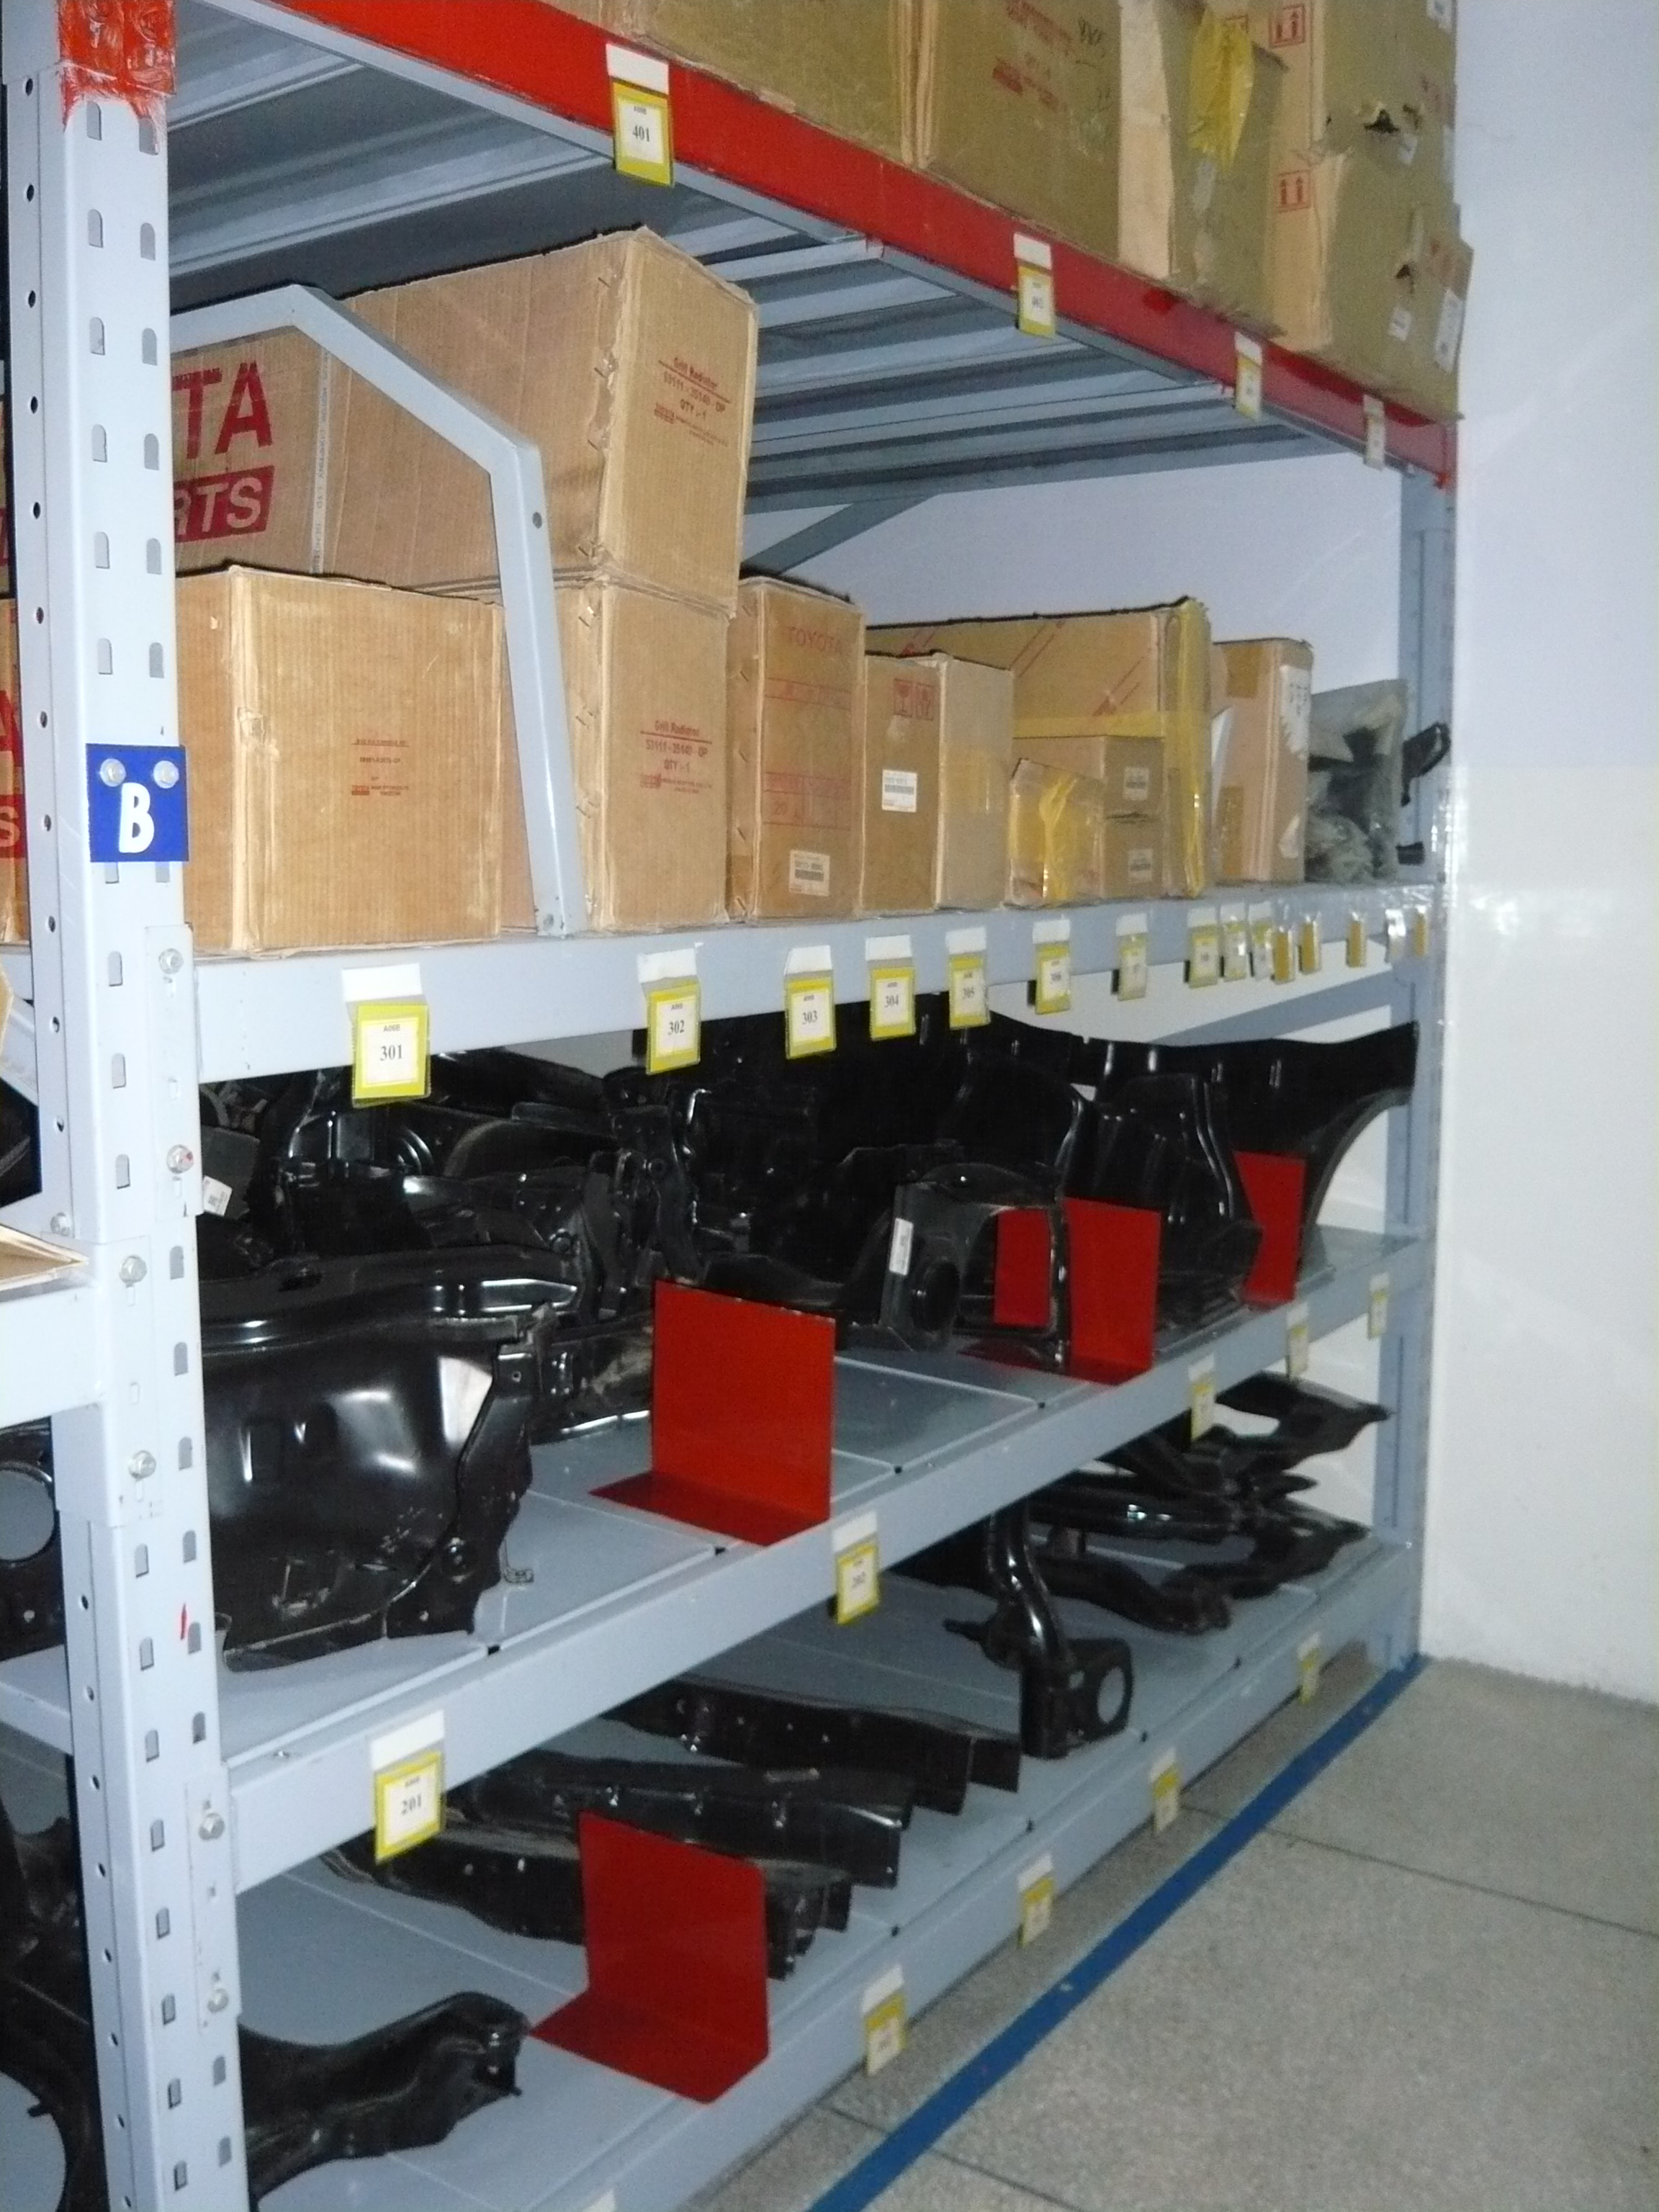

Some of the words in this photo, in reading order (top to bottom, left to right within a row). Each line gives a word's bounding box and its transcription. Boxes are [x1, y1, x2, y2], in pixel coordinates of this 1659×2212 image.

[632, 125, 650, 142] 401
[118, 782, 155, 853] B
[884, 994, 899, 1008] 304
[801, 1010, 818, 1025] 303
[667, 1020, 685, 1035] 302
[379, 1044, 403, 1061] 301
[400, 1792, 422, 1816] 201
